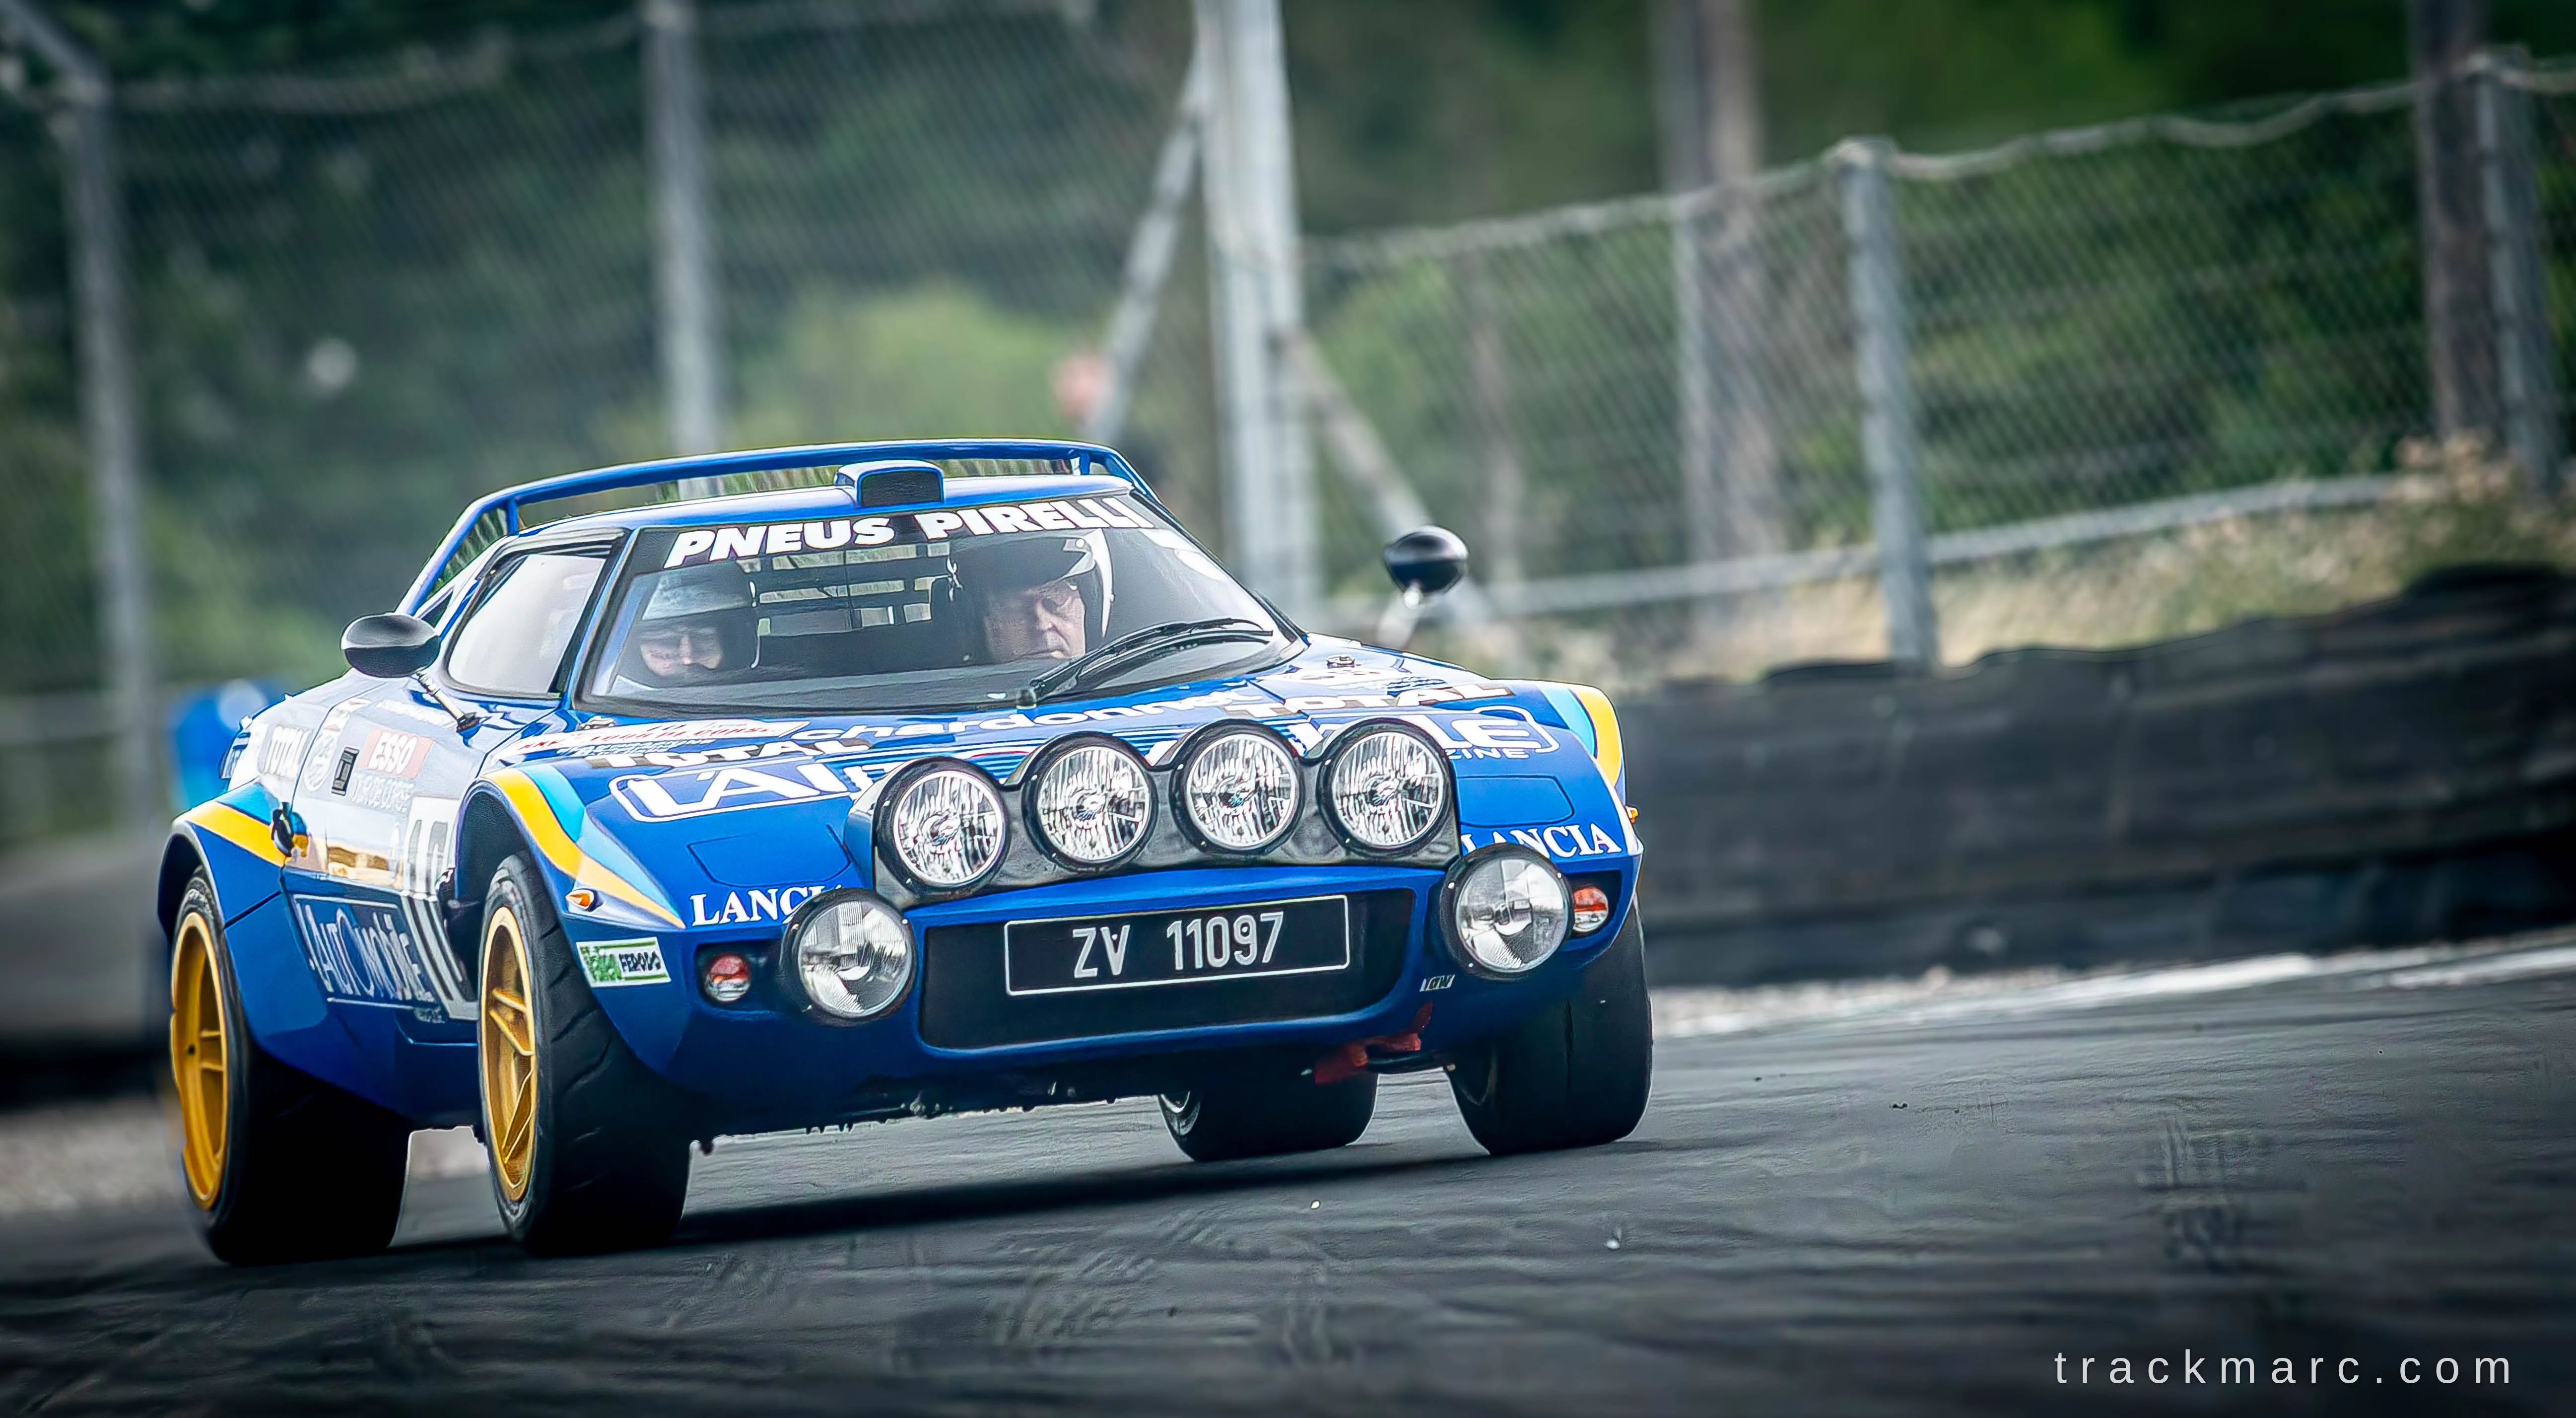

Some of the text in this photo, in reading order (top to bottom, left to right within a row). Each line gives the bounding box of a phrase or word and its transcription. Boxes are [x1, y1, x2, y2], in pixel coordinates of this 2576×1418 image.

[664, 497, 1153, 568] PNEUS PIRELLI
[1224, 684, 1510, 717] TOTAL
[366, 732, 418, 774] ESSO
[596, 742, 870, 768] TOTAL
[1444, 747, 1530, 759] ZINE
[1072, 911, 1284, 979] ZV 11097
